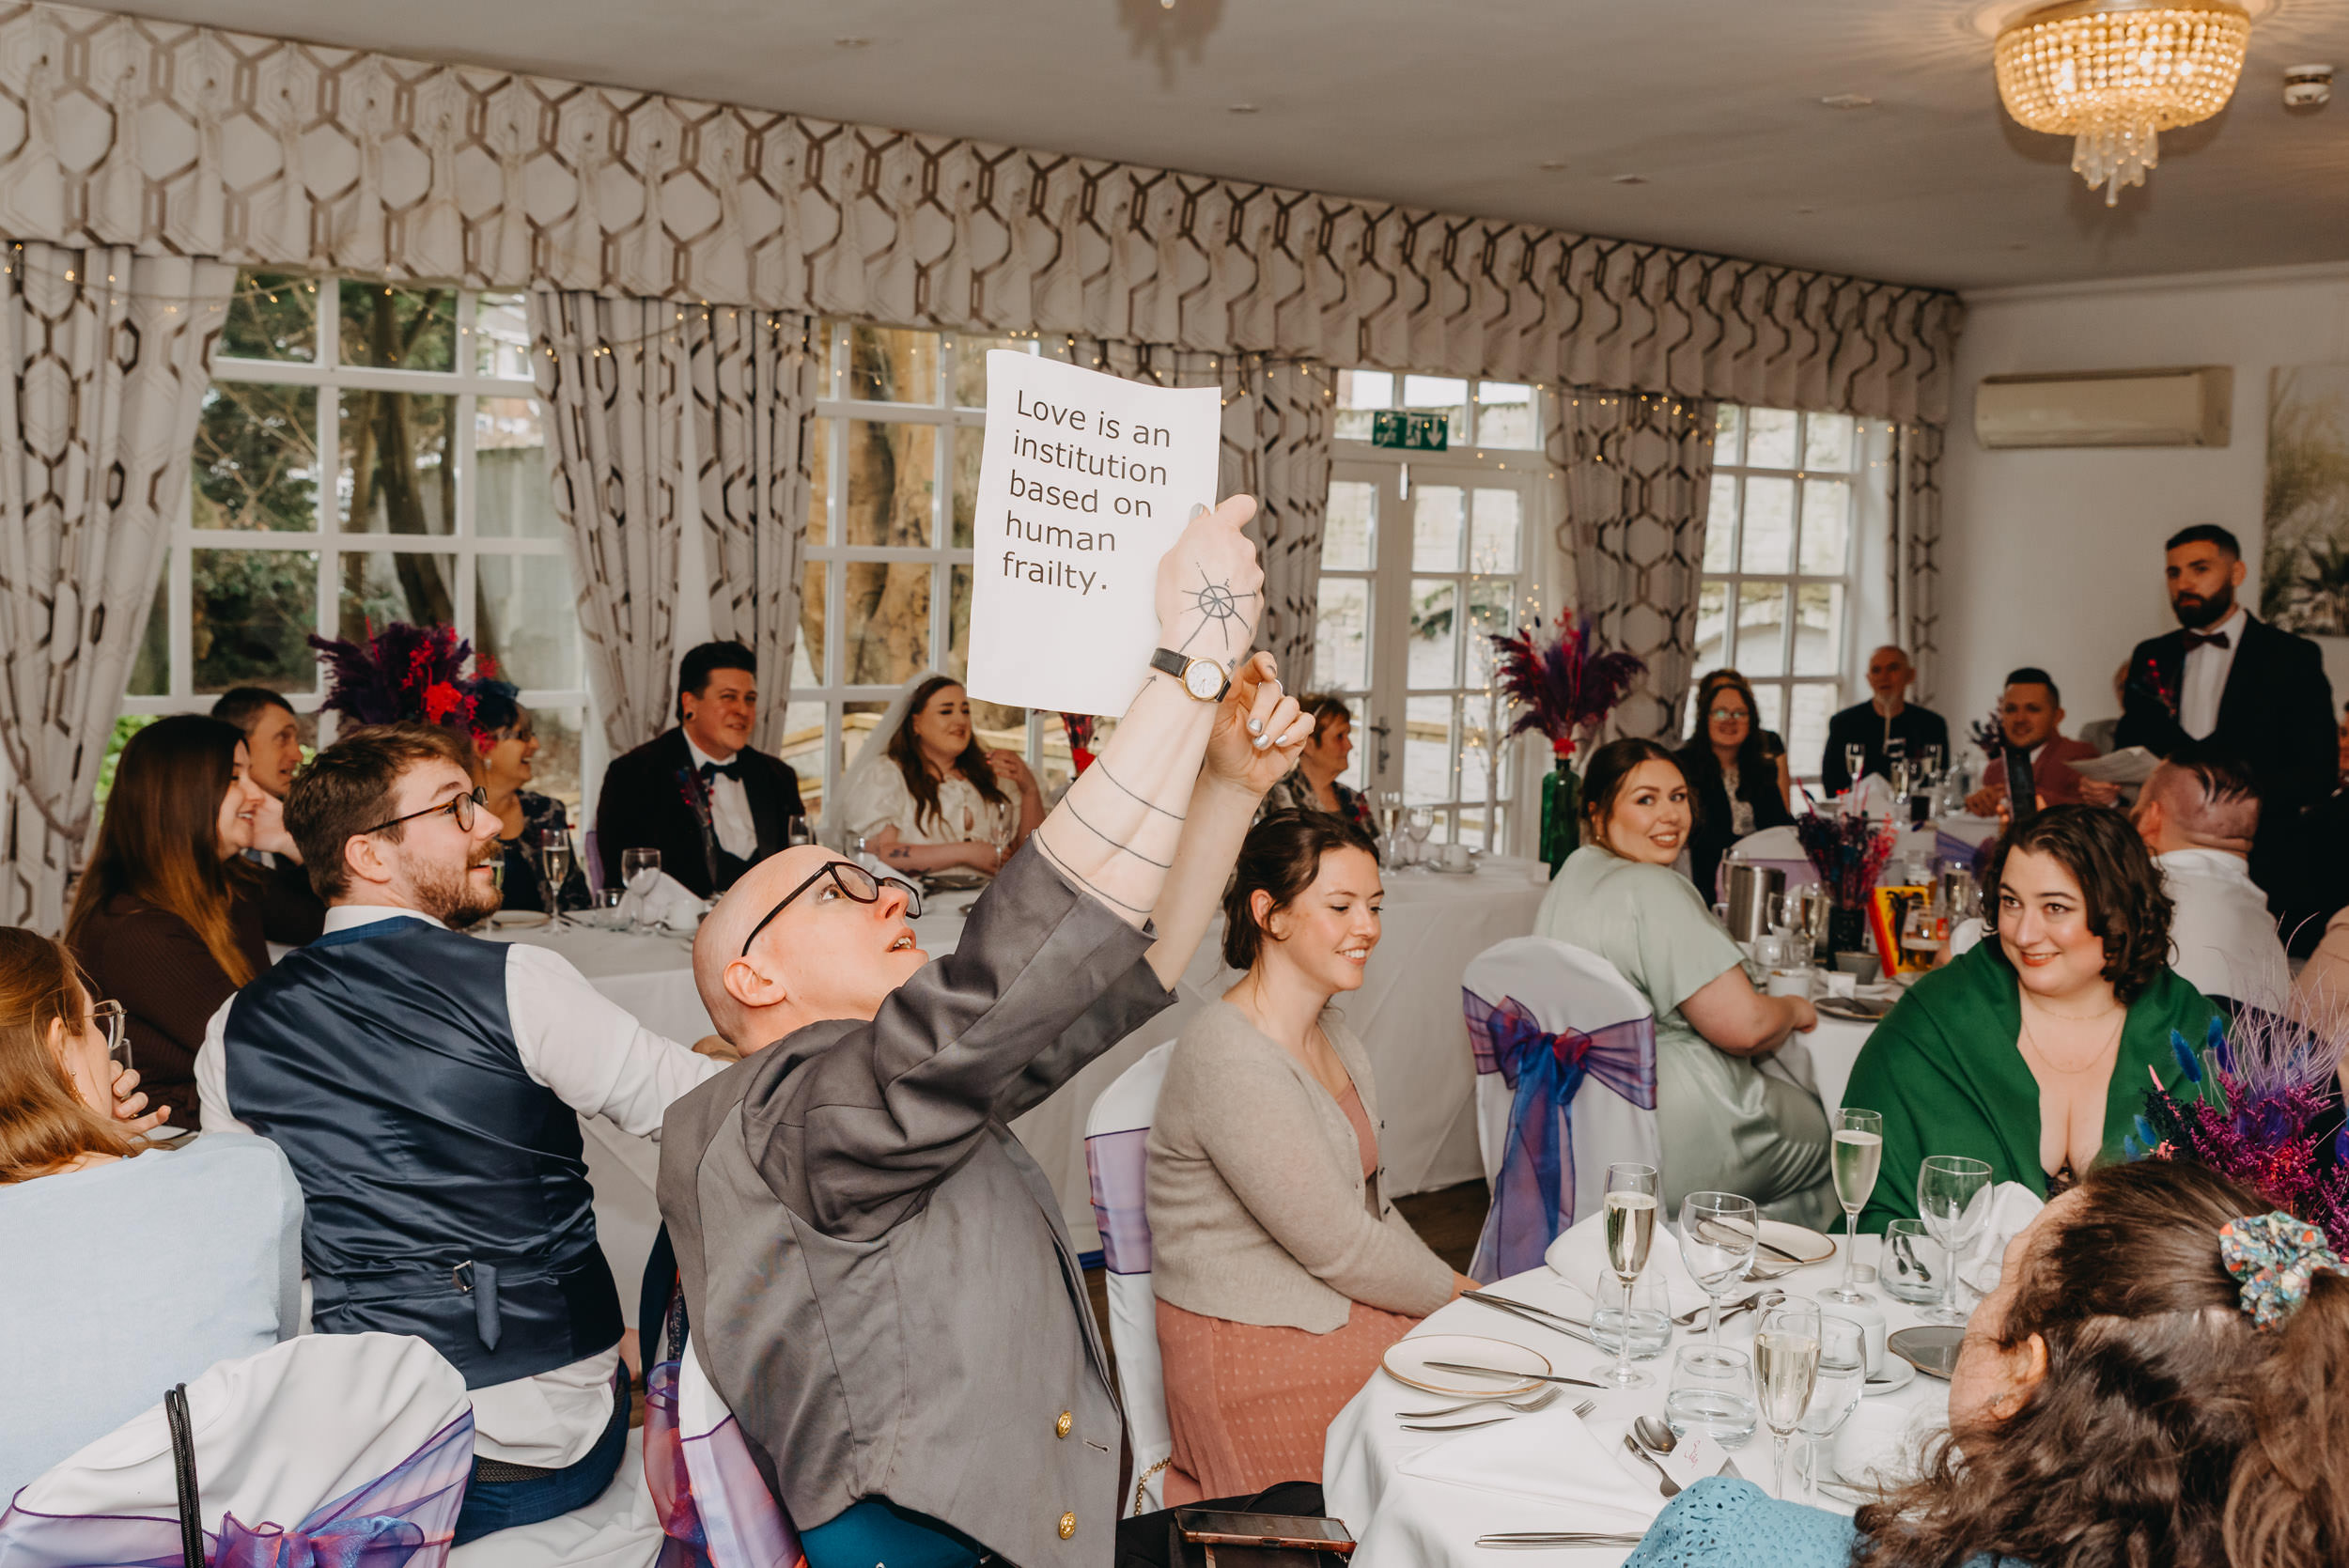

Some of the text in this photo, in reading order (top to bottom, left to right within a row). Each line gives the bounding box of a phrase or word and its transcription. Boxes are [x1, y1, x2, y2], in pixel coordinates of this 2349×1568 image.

[1018, 390, 1171, 448] Love is an
[1014, 429, 1167, 486] institution
[1010, 469, 1152, 519] based on
[1006, 510, 1115, 552] human
[1003, 551, 1108, 596] frailty.
